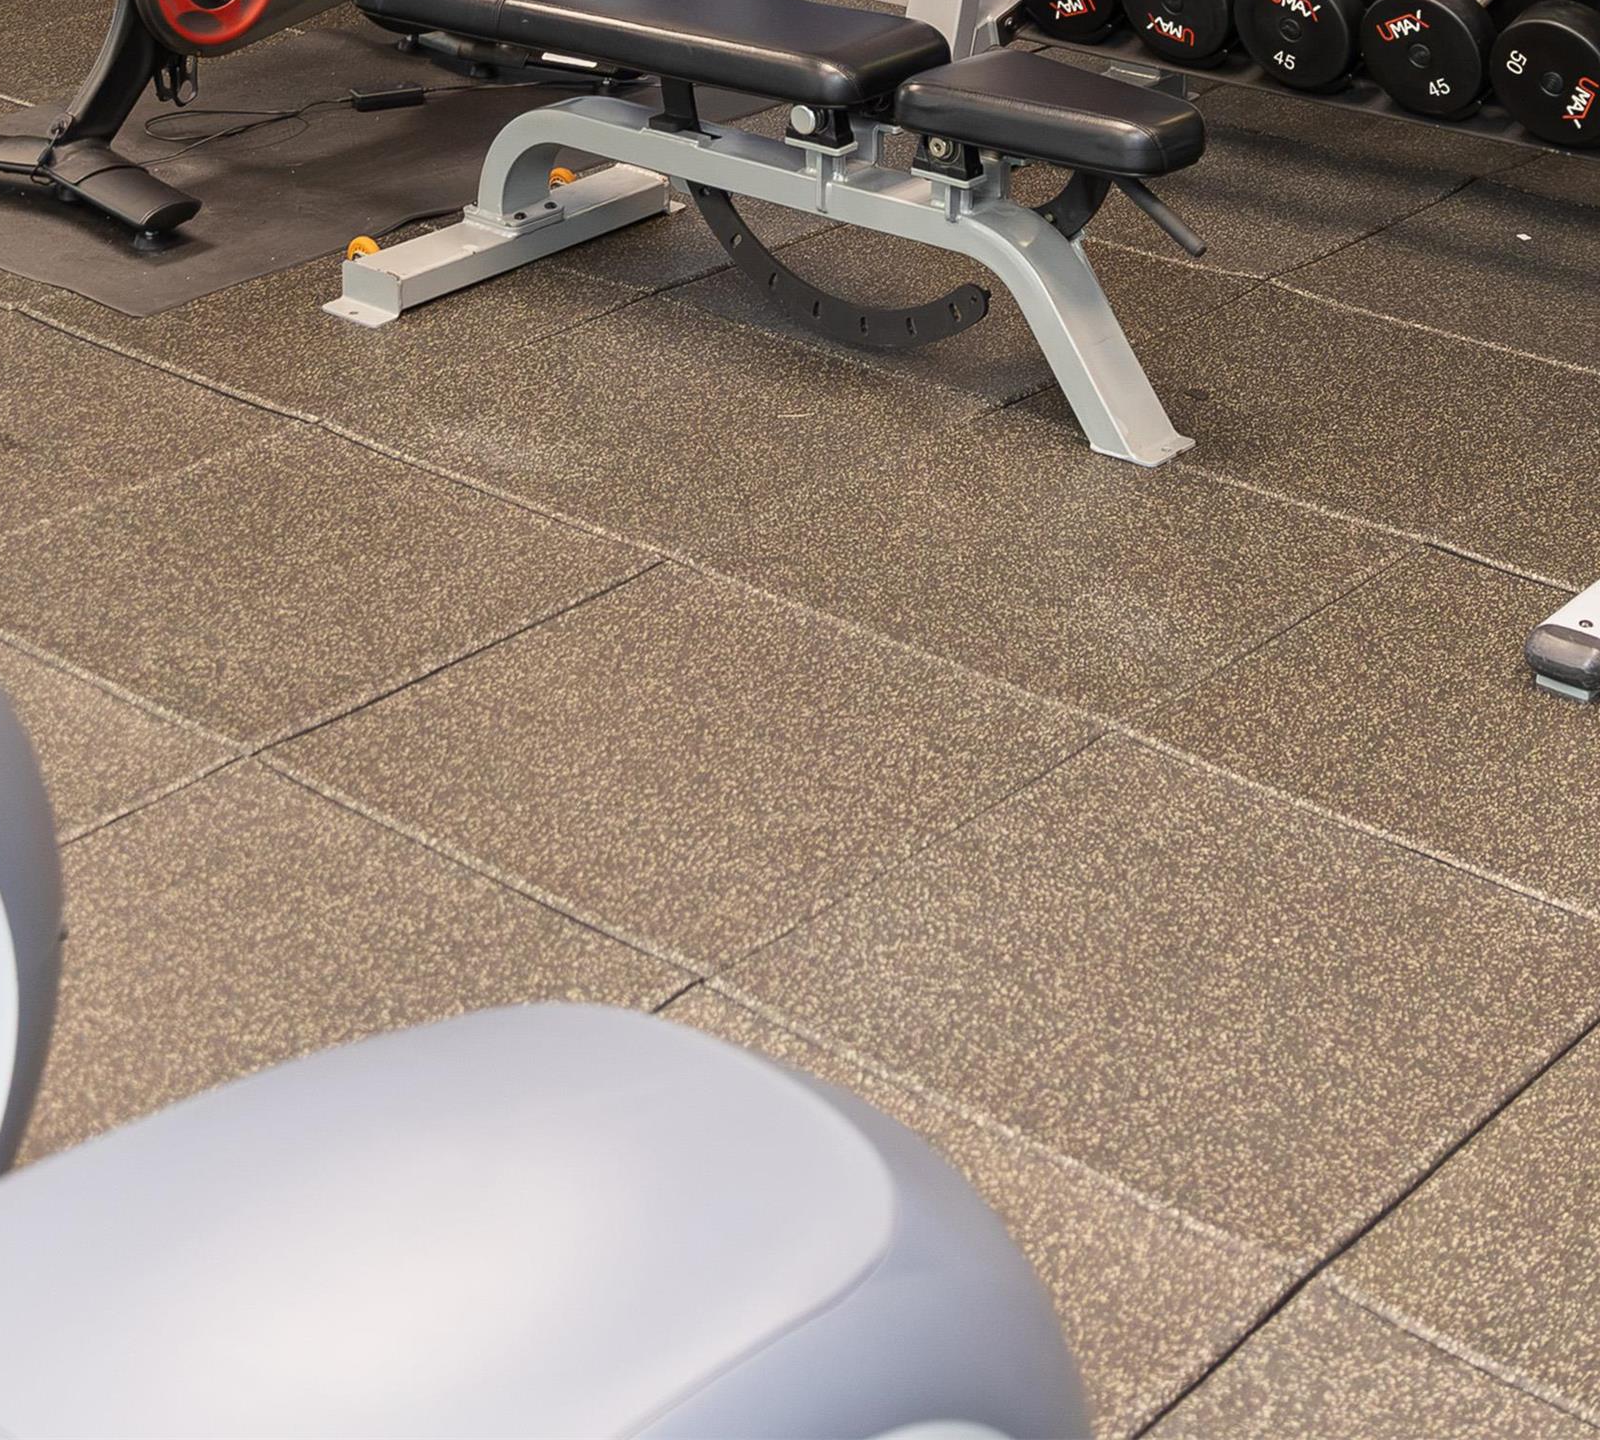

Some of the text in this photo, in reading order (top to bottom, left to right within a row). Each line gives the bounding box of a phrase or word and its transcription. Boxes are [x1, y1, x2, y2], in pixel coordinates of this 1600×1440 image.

[1146, 13, 1195, 46] UMAX
[1376, 9, 1429, 41] UMAX
[1273, 50, 1296, 70] 45
[1506, 50, 1528, 75] 50
[1429, 77, 1451, 97] 45
[1562, 76, 1599, 129] UMAX
